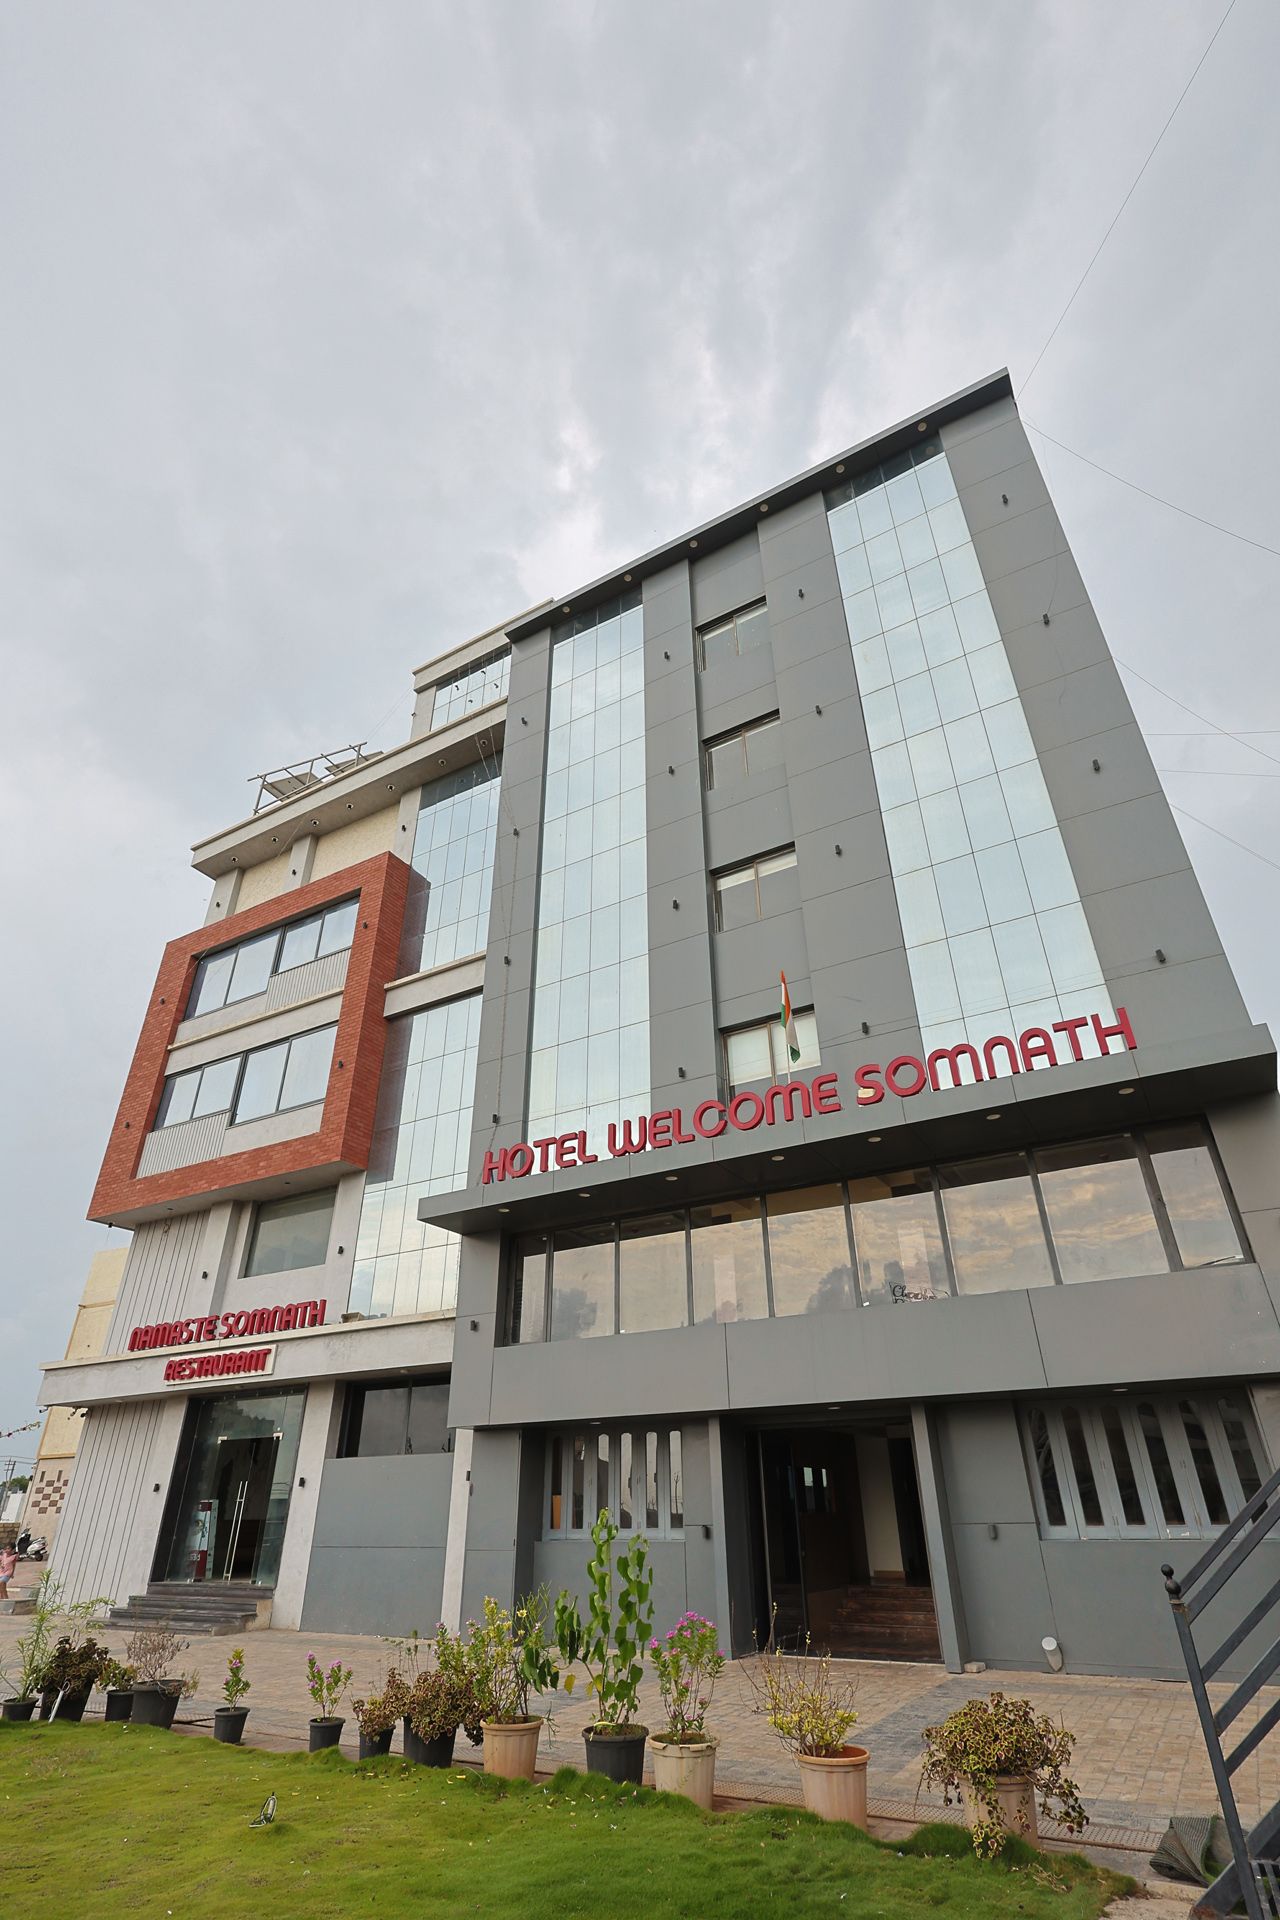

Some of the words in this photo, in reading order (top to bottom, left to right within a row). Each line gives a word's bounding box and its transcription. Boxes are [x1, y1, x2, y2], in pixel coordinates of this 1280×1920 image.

[482, 1130, 598, 1184] HOTEL
[608, 1072, 841, 1157] WELCOME
[855, 1007, 1138, 1106] SOMNATH
[128, 1315, 219, 1350] NAMASTE
[219, 1299, 327, 1337] SOMNATH
[164, 1348, 271, 1380] RESTAURANT
